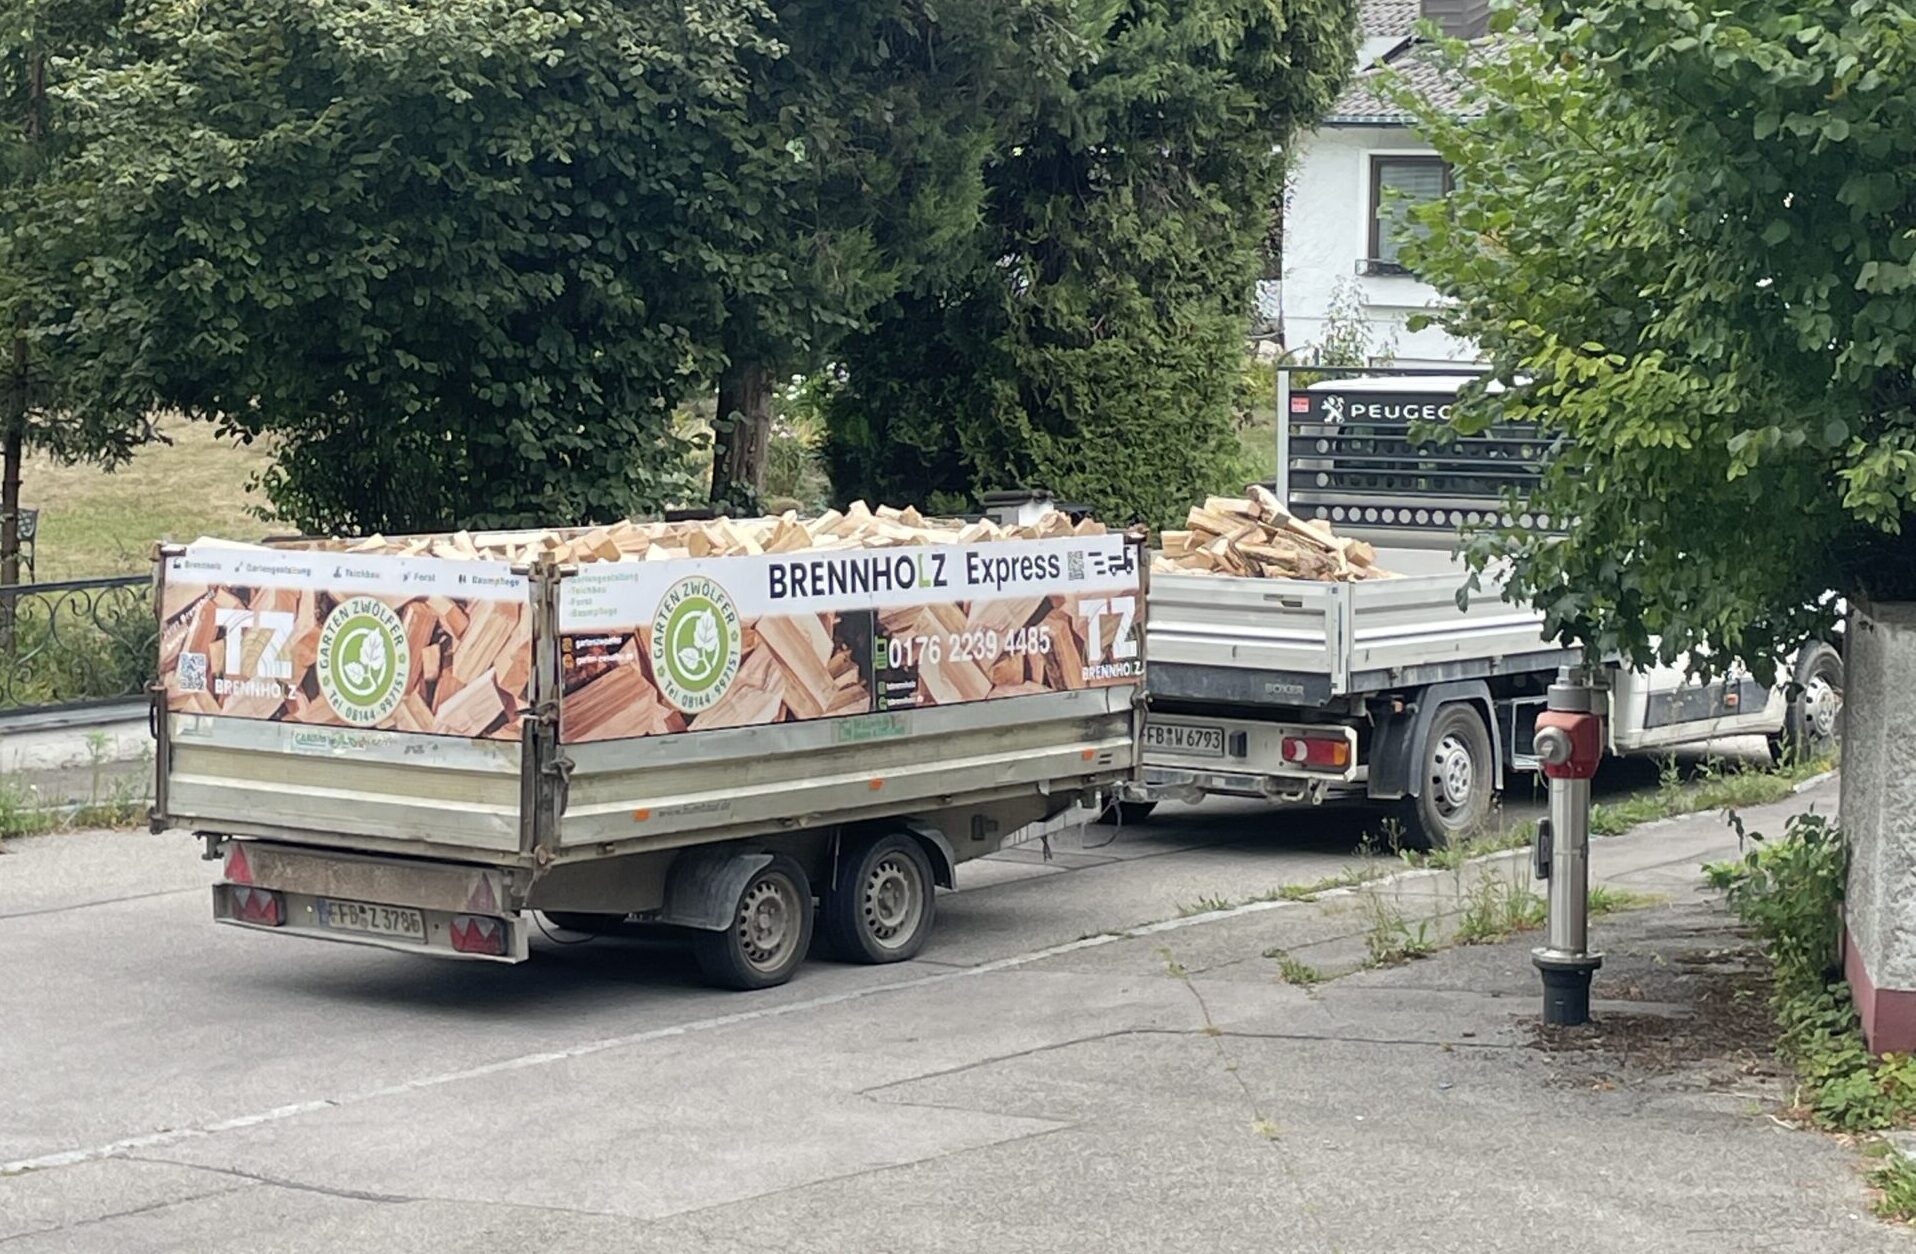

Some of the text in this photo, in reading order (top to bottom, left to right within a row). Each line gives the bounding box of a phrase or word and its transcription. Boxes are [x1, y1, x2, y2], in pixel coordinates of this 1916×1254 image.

[1350, 403, 1453, 420] PEUGEO
[769, 552, 1061, 599] BRENNHOLZ Express
[214, 607, 294, 679] TZ
[319, 606, 350, 670] GARTEN
[653, 580, 735, 660] GARTEN ZWÖLFER
[1078, 596, 1137, 662] TZ
[888, 626, 1050, 669] 0176 2239 4485
[1143, 726, 1220, 749] FB W 6793
[368, 907, 380, 928] Z
